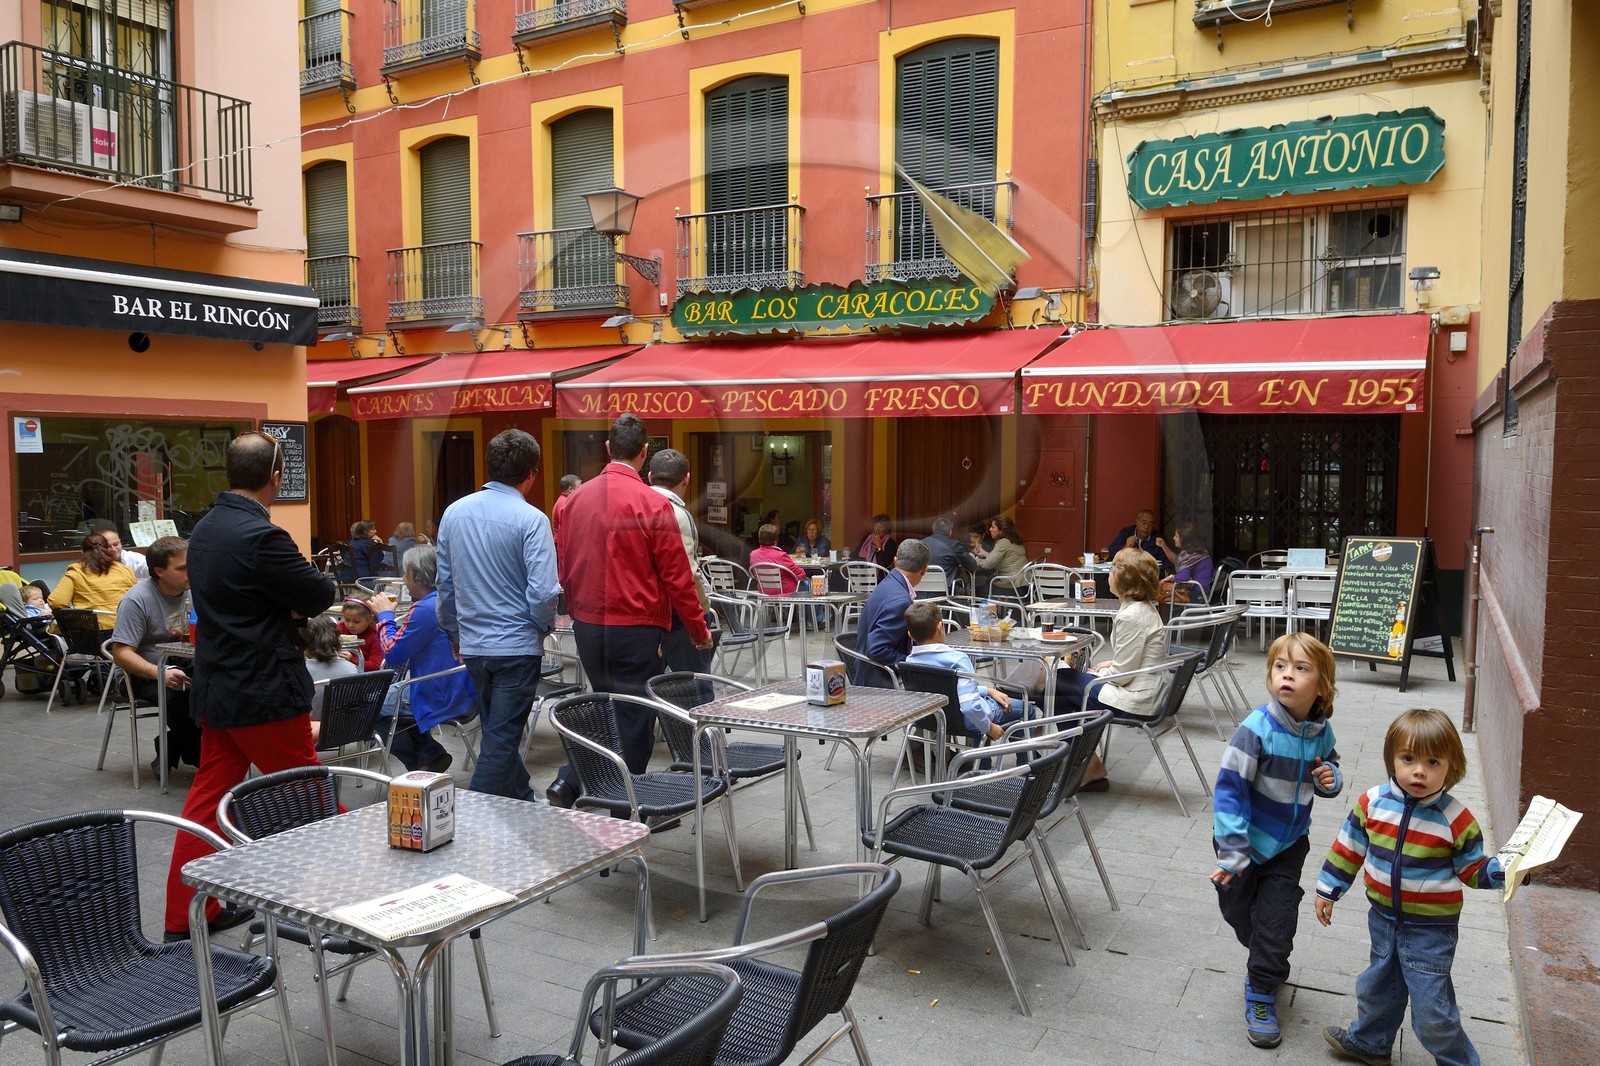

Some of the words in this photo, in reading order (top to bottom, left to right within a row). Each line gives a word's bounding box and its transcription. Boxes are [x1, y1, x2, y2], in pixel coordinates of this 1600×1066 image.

[1144, 143, 1232, 196] CASA
[1238, 123, 1429, 187] ANTONIO
[112, 294, 165, 319] BAR
[169, 300, 198, 322] EL
[202, 304, 290, 331] RINCÓN
[684, 299, 738, 325] BAR
[751, 297, 798, 320] LOS
[816, 287, 983, 319] CARACOLES
[356, 392, 434, 415] CARNES
[450, 384, 545, 409] IBERICAS
[579, 391, 694, 414] MARISCO
[721, 387, 848, 413] PESCADO
[864, 385, 980, 410] FRESCO
[1025, 379, 1233, 408] FUNDADA
[1258, 378, 1328, 407] EN
[1343, 377, 1417, 406] 1955
[1348, 542, 1374, 559] TAPAS
[1340, 594, 1368, 602] PAELLA
